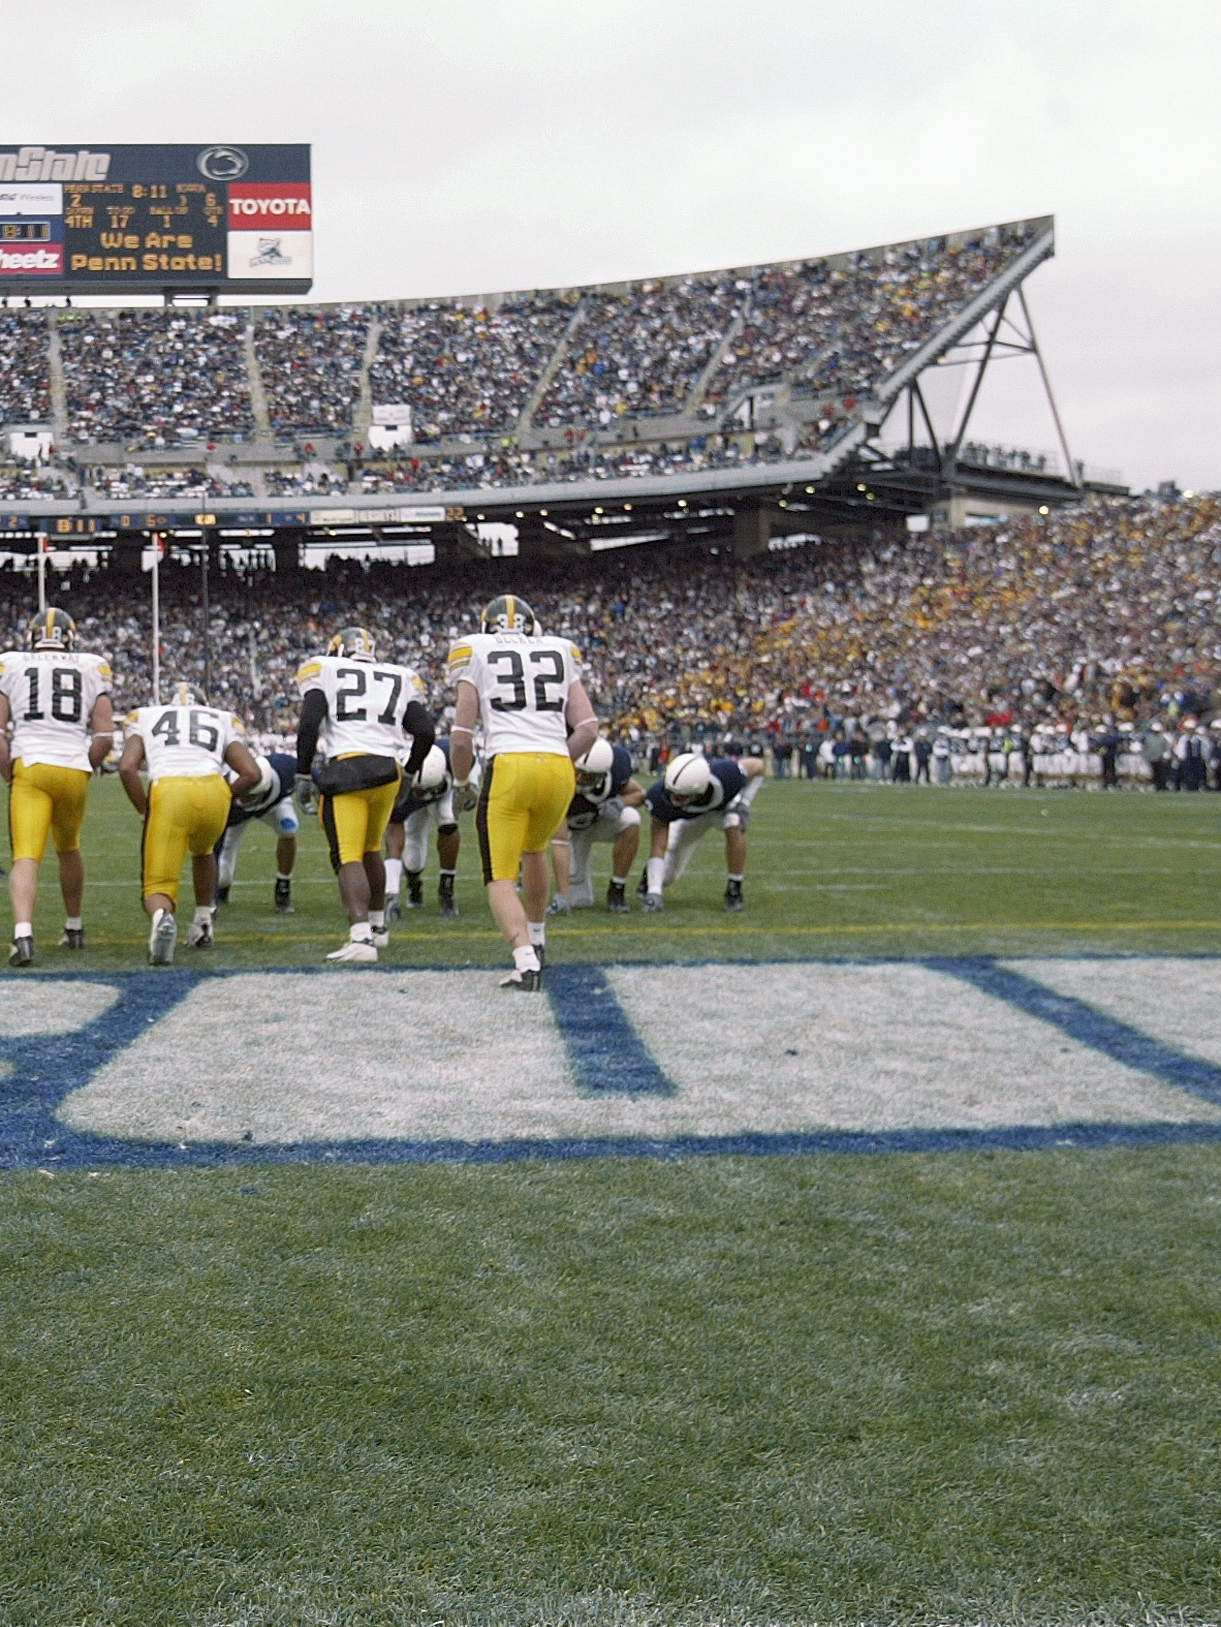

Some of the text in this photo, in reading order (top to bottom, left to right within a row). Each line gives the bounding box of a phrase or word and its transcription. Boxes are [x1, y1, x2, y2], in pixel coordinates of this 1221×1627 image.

[229, 198, 311, 215] TOYOTA
[64, 215, 93, 228] 4TH
[110, 215, 130, 228] 17
[100, 231, 193, 249] We Are
[71, 253, 222, 272] Penn State!
[487, 650, 565, 712] 32
[23, 667, 84, 723] 18
[336, 668, 401, 725] 27
[151, 710, 219, 752] 46
